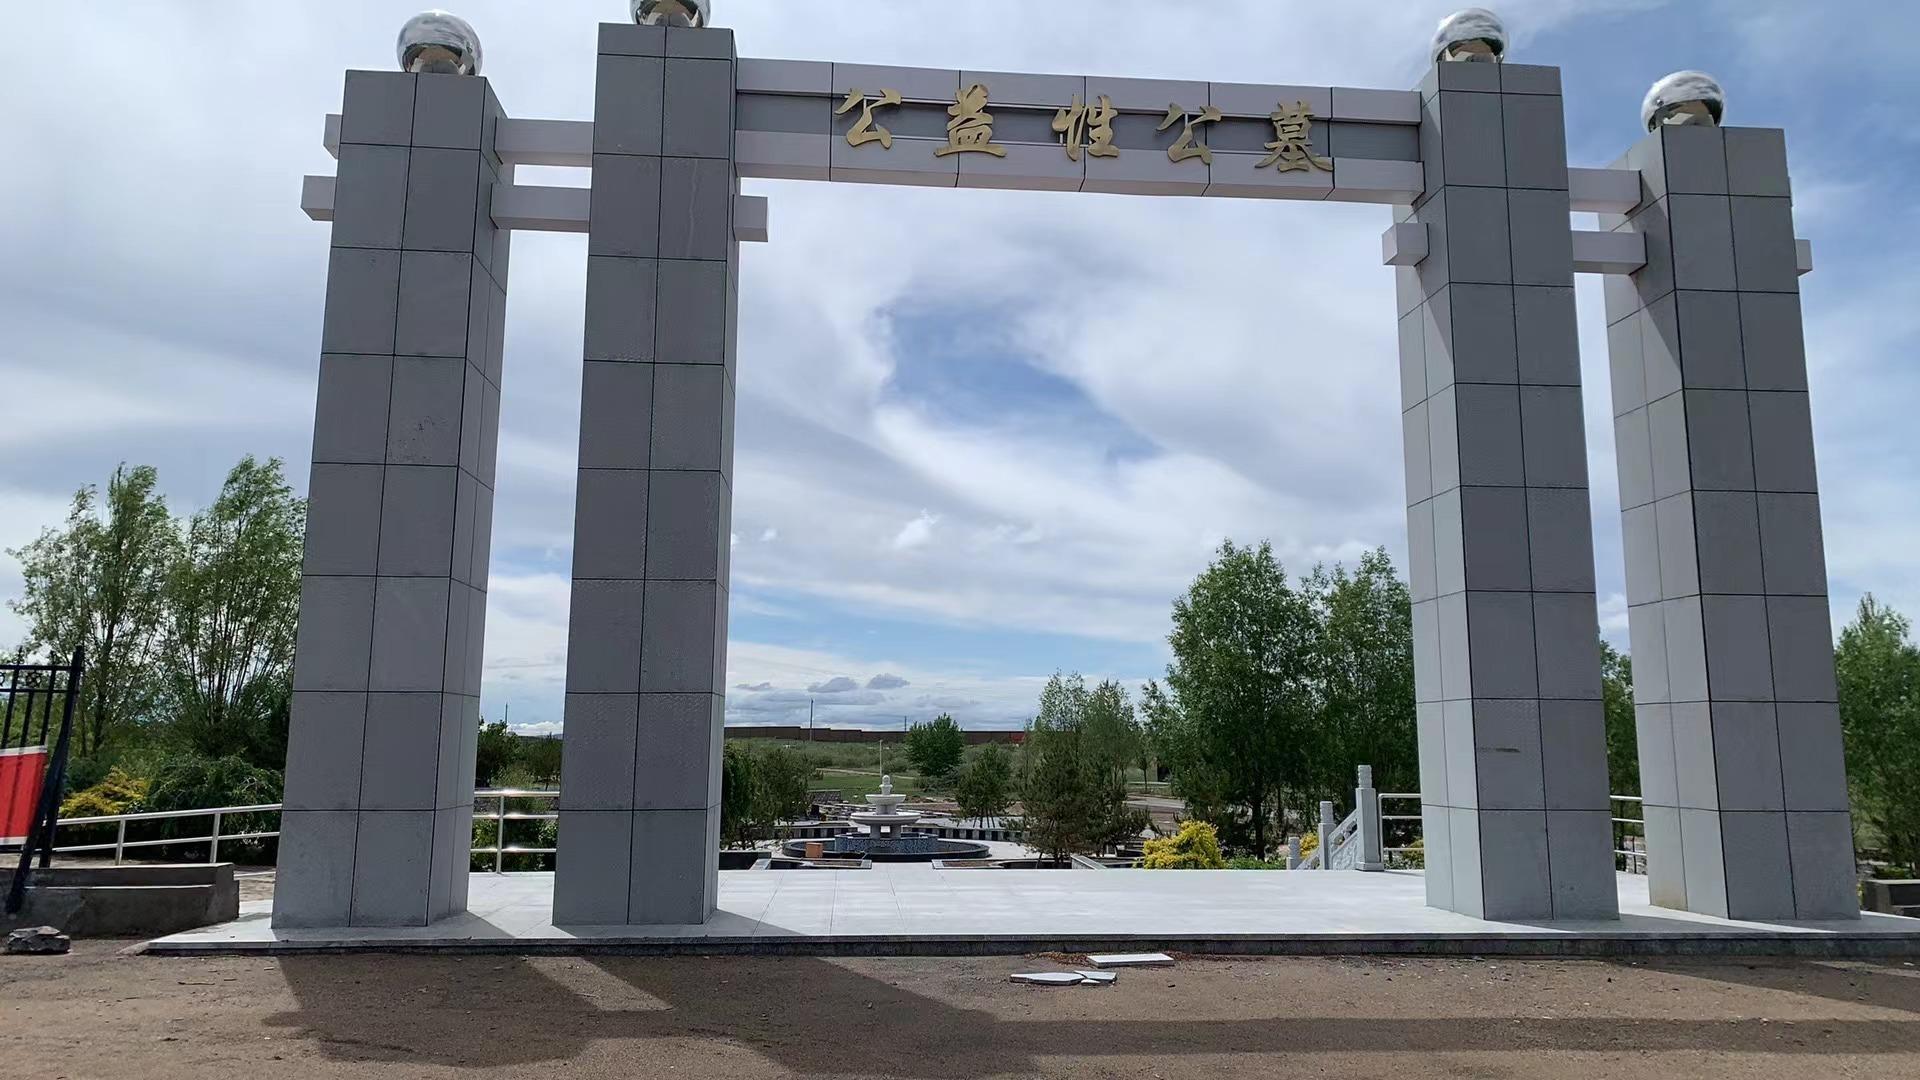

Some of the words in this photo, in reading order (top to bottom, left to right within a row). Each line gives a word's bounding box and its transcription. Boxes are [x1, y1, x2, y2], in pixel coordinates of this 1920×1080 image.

[834, 83, 1333, 172] 公益性公墓
